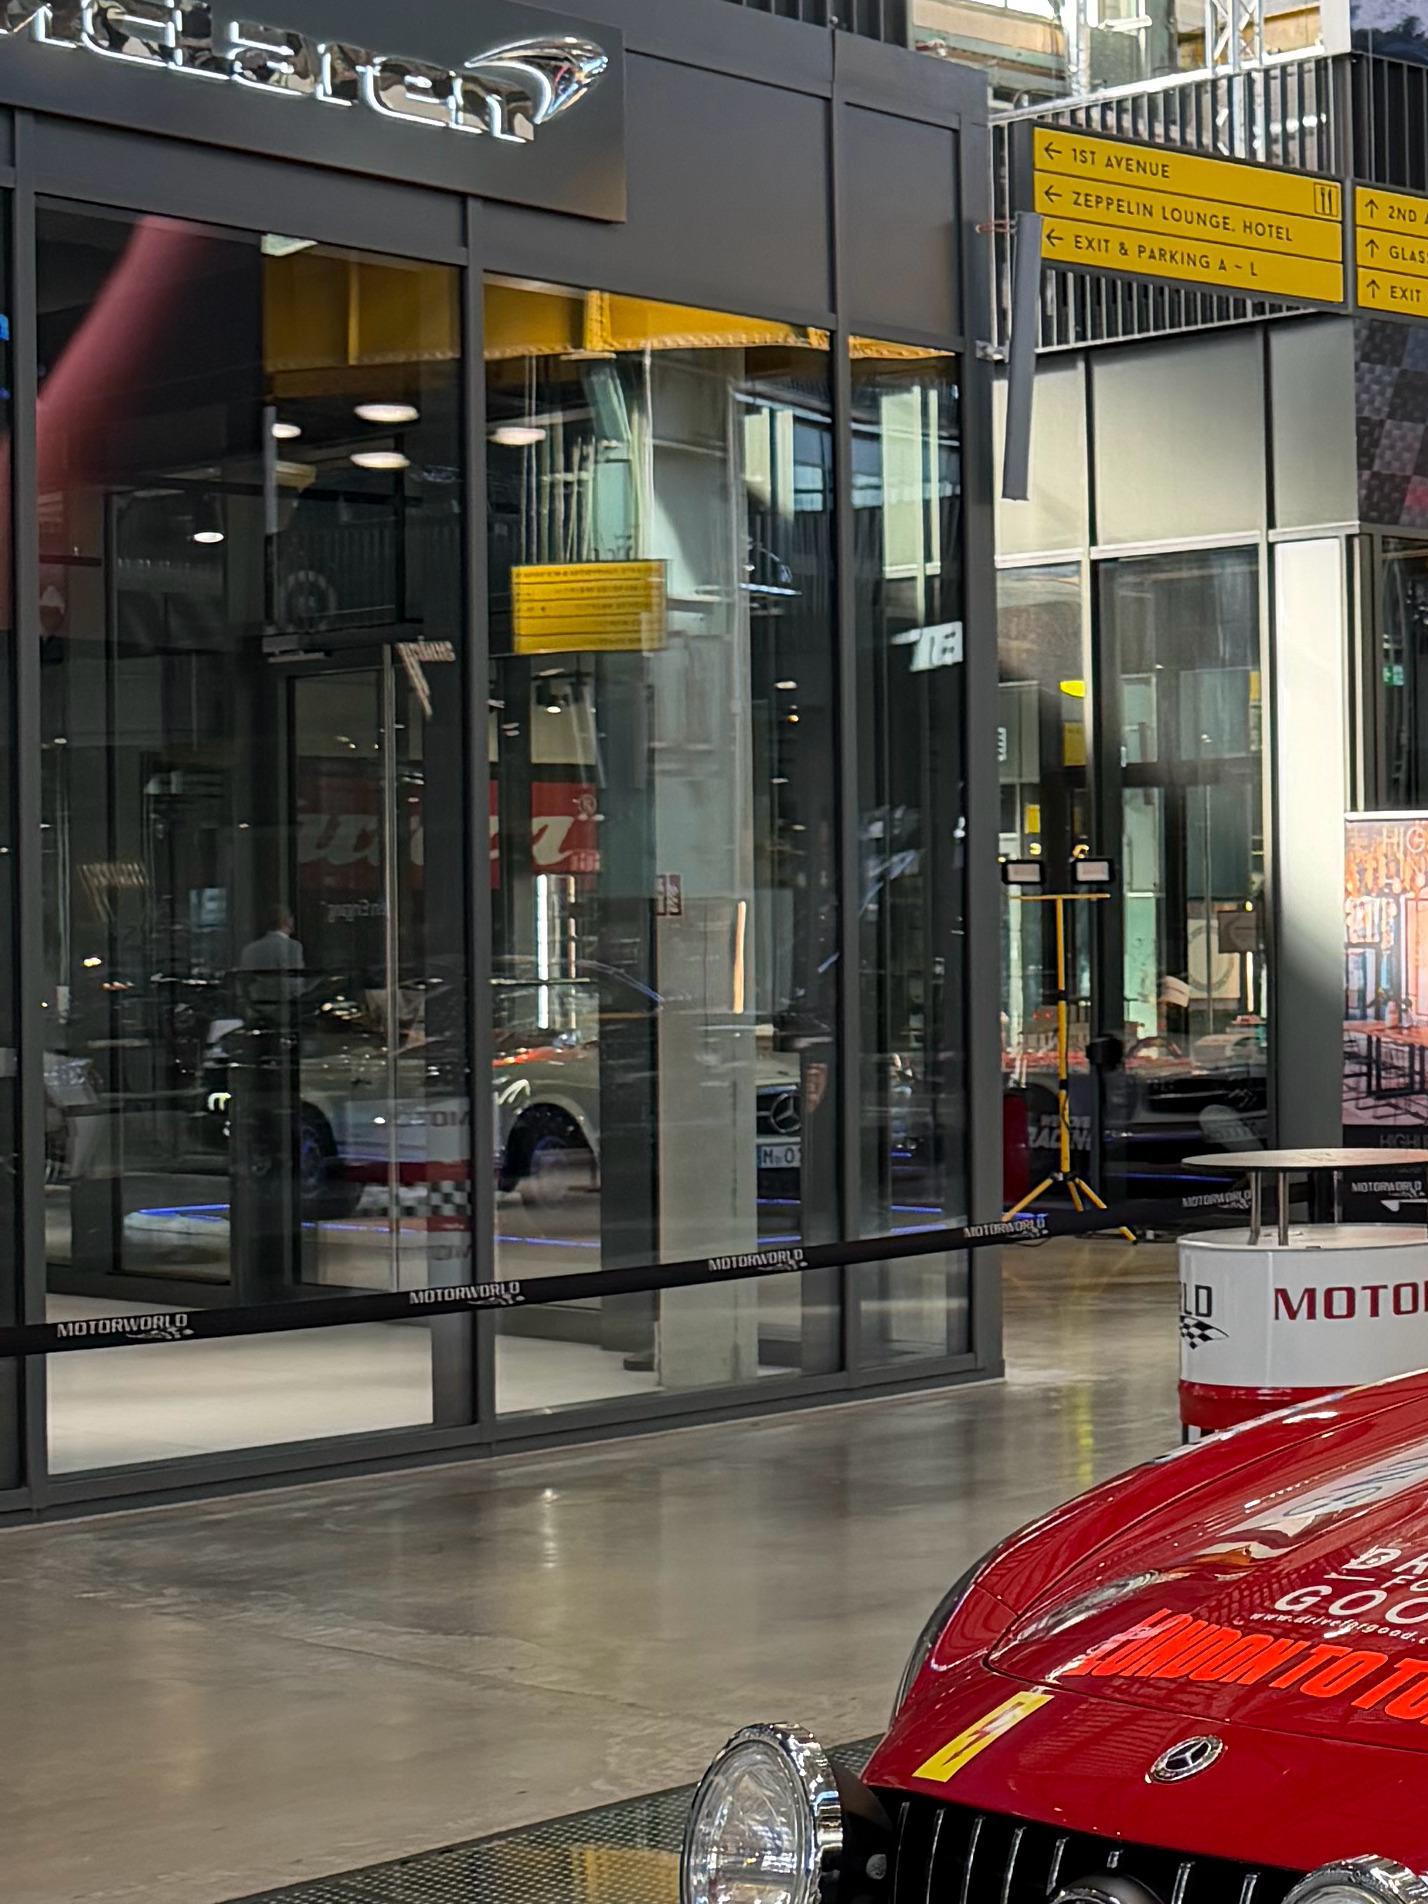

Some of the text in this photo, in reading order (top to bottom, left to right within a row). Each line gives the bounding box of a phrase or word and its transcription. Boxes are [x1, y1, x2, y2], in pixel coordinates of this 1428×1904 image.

[1072, 147, 1171, 180] 1ST AVENUE
[1072, 191, 1154, 219] ZEPPELIN
[1243, 220, 1293, 243] HOTEL
[1388, 205, 1417, 223] 2ND
[1074, 234, 1110, 254] EXIT
[1119, 241, 1129, 257] &
[1137, 244, 1210, 270] PARKING
[1218, 257, 1228, 272] A
[1250, 261, 1259, 277] L
[1390, 285, 1422, 305] EXIT
[1352, 1180, 1422, 1193] MOTORWORLD
[963, 1218, 1045, 1238] MOTORWORLD
[707, 1248, 804, 1272] MOTORWORLD
[409, 1280, 521, 1306] MOTORWORLD
[56, 1311, 189, 1340] MOTORWORLD
[1269, 1643, 1390, 1698] TO
